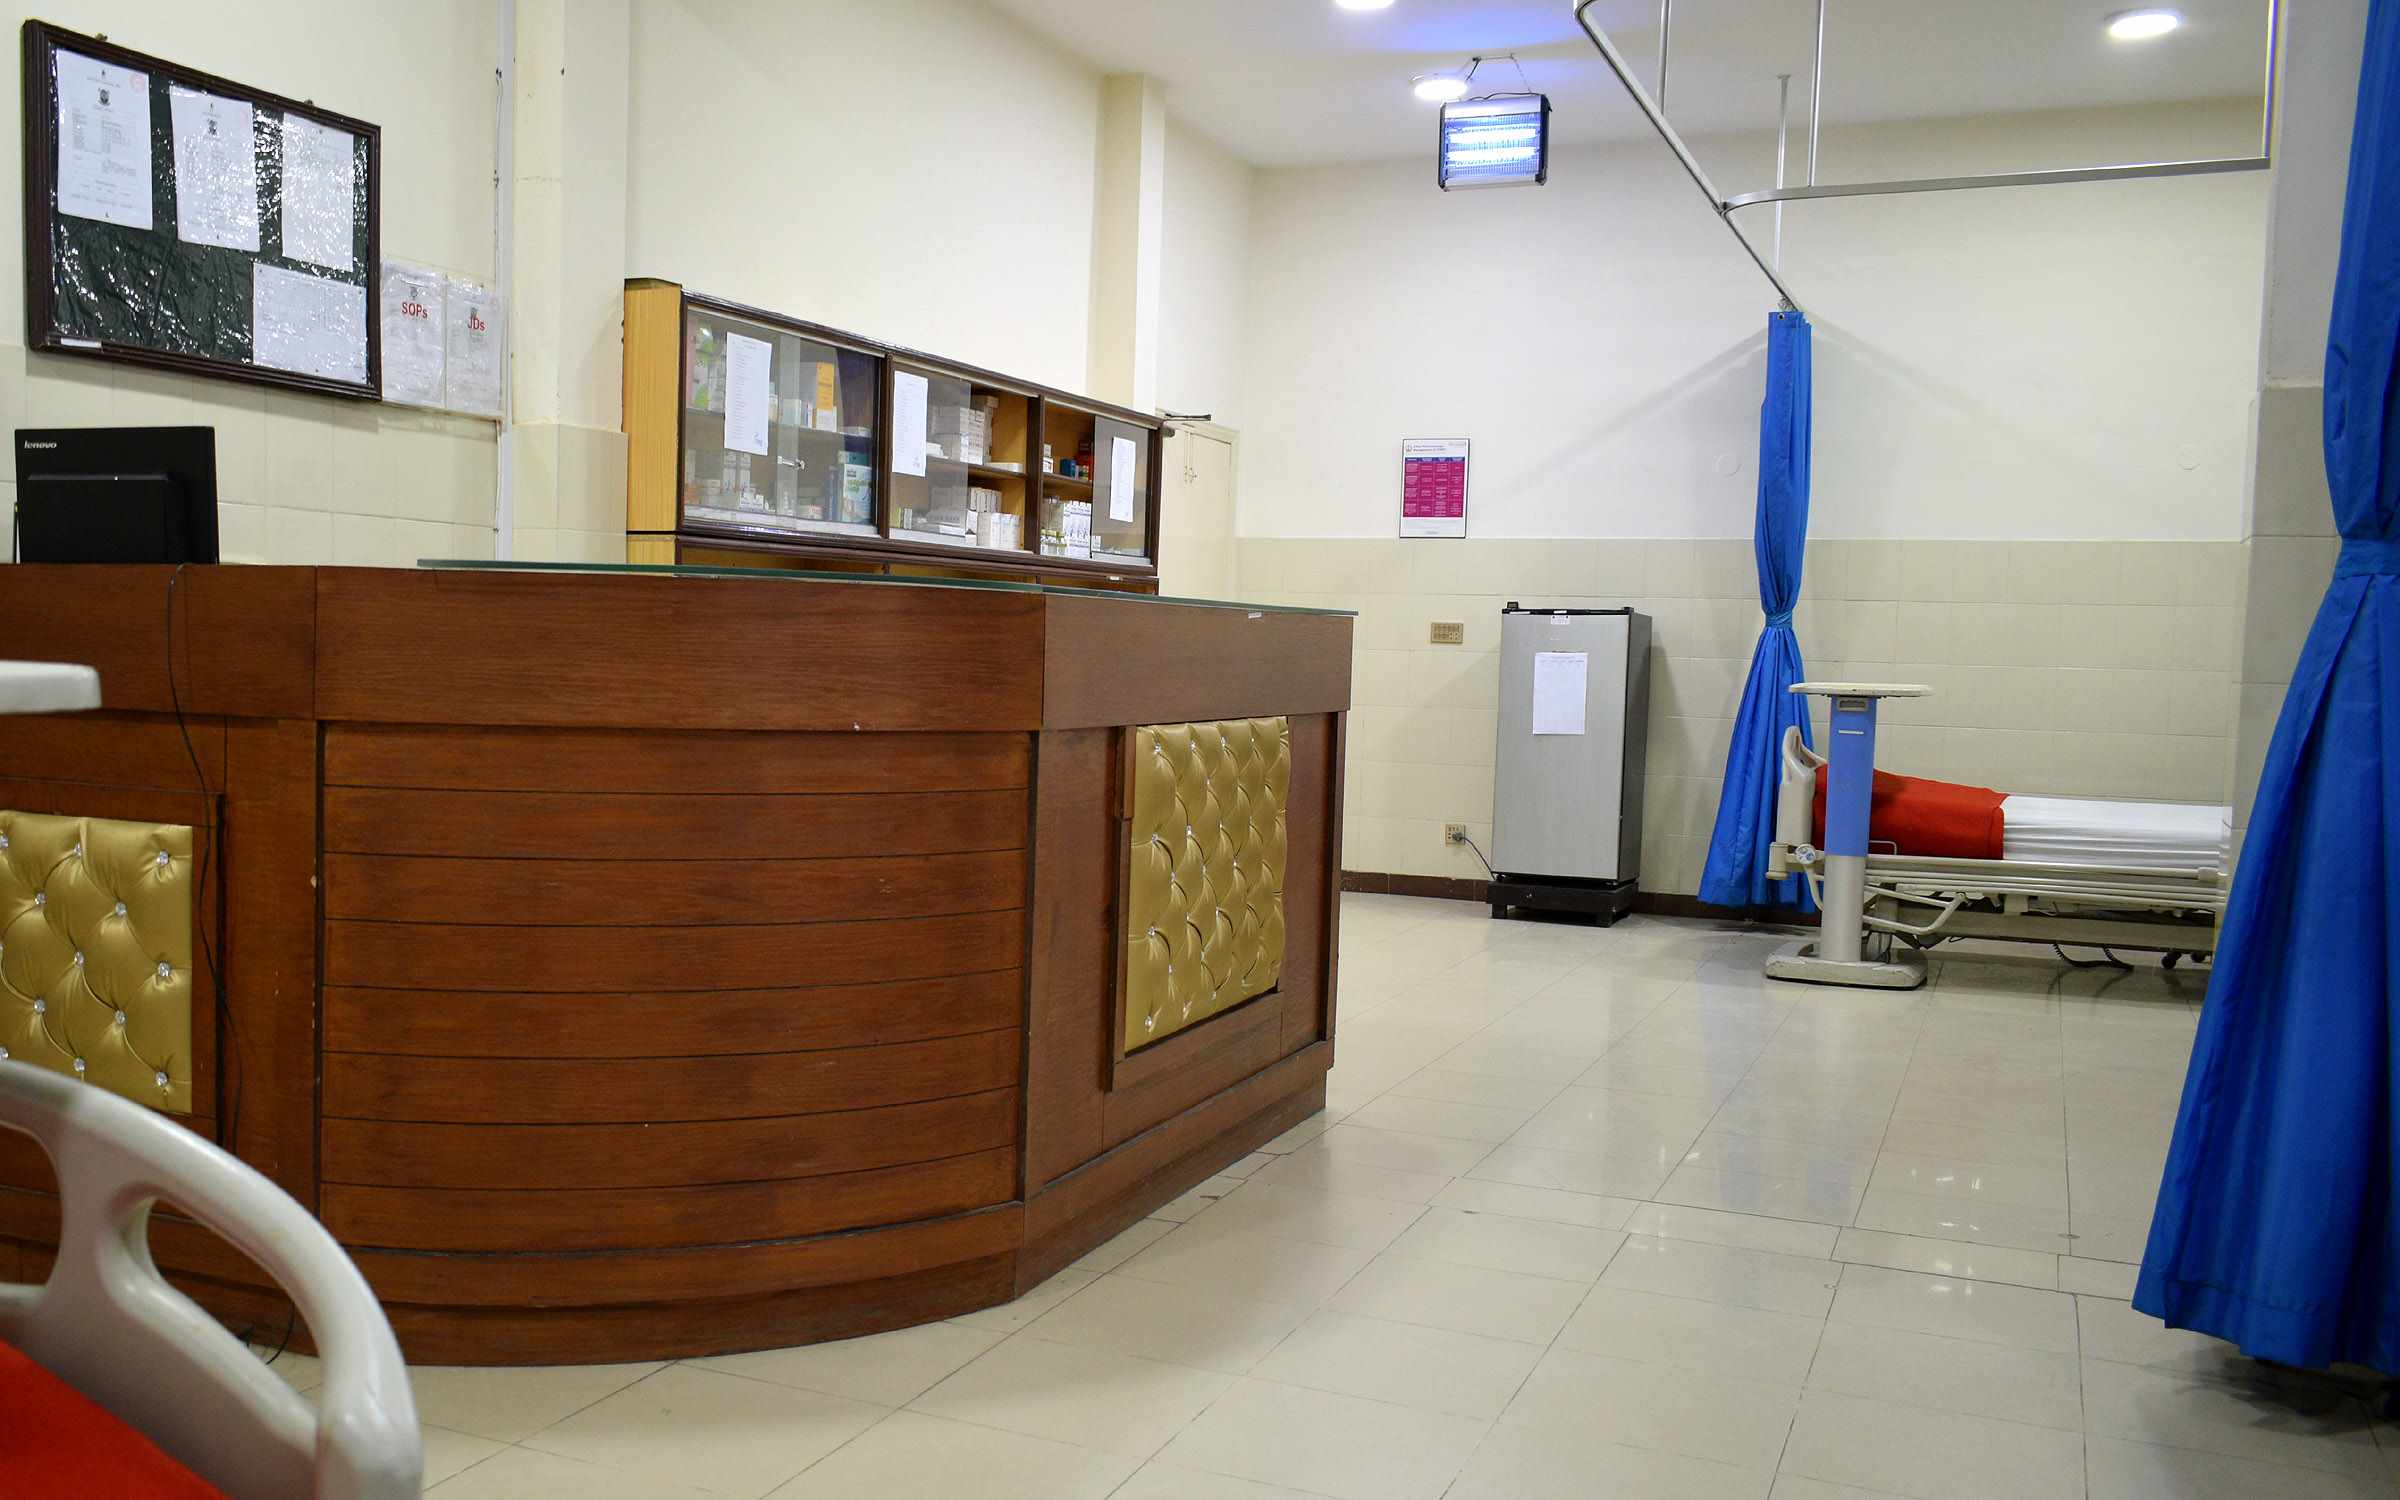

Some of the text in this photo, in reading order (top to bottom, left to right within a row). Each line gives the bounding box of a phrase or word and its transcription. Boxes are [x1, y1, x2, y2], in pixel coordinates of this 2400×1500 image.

[401, 302, 428, 318] SOPs
[467, 315, 486, 331] JDs
[24, 440, 57, 449] lenovo
